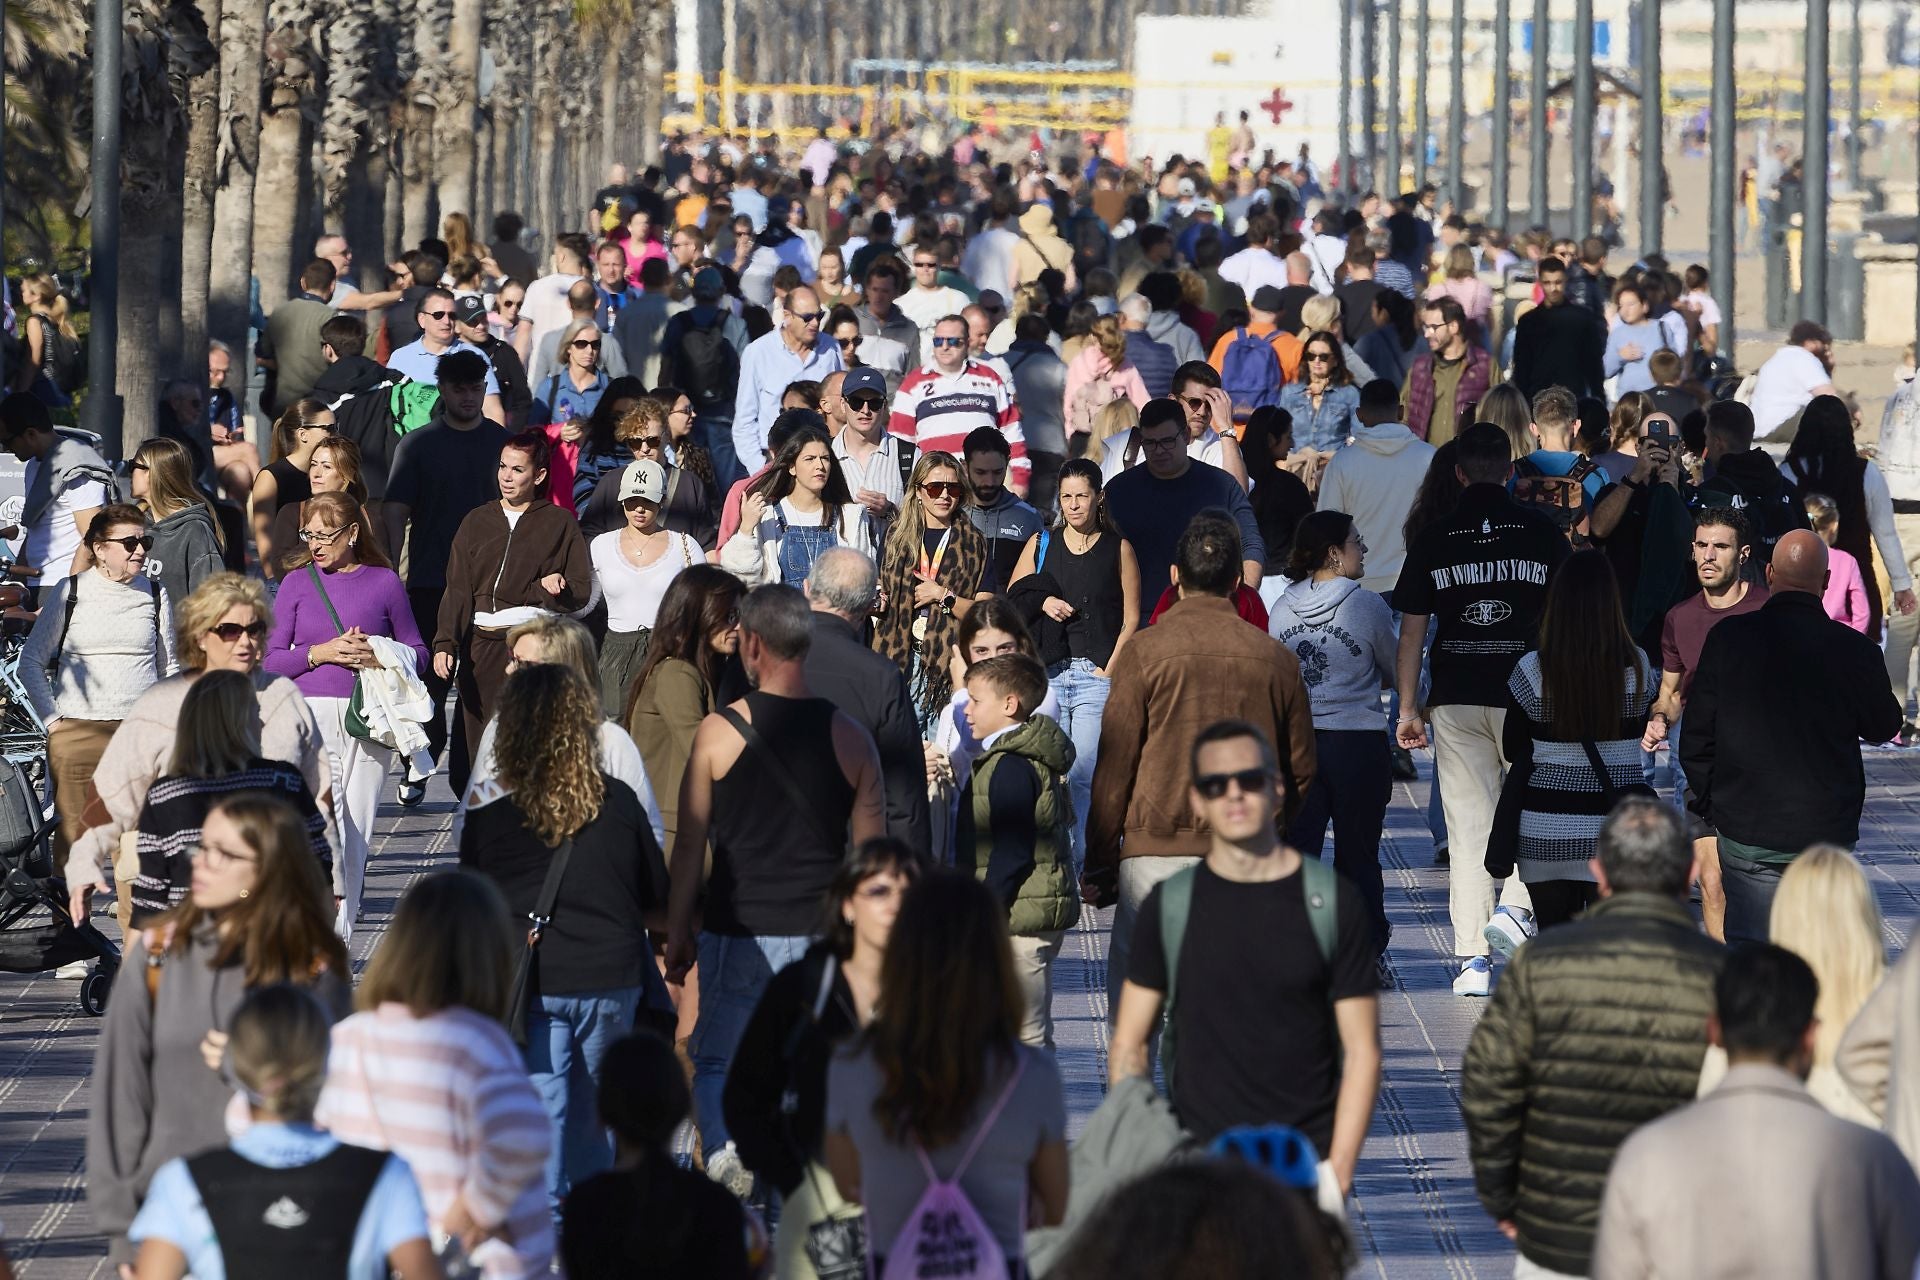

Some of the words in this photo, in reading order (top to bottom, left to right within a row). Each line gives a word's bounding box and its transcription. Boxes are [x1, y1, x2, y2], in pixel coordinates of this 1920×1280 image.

[923, 382, 935, 396] 2
[634, 470, 648, 484] NY
[1000, 527, 1019, 537] PUMA
[1430, 567, 1451, 590] THE
[1451, 561, 1494, 586] WORLD
[1495, 559, 1508, 582] IS
[1510, 558, 1548, 586] YOURS
